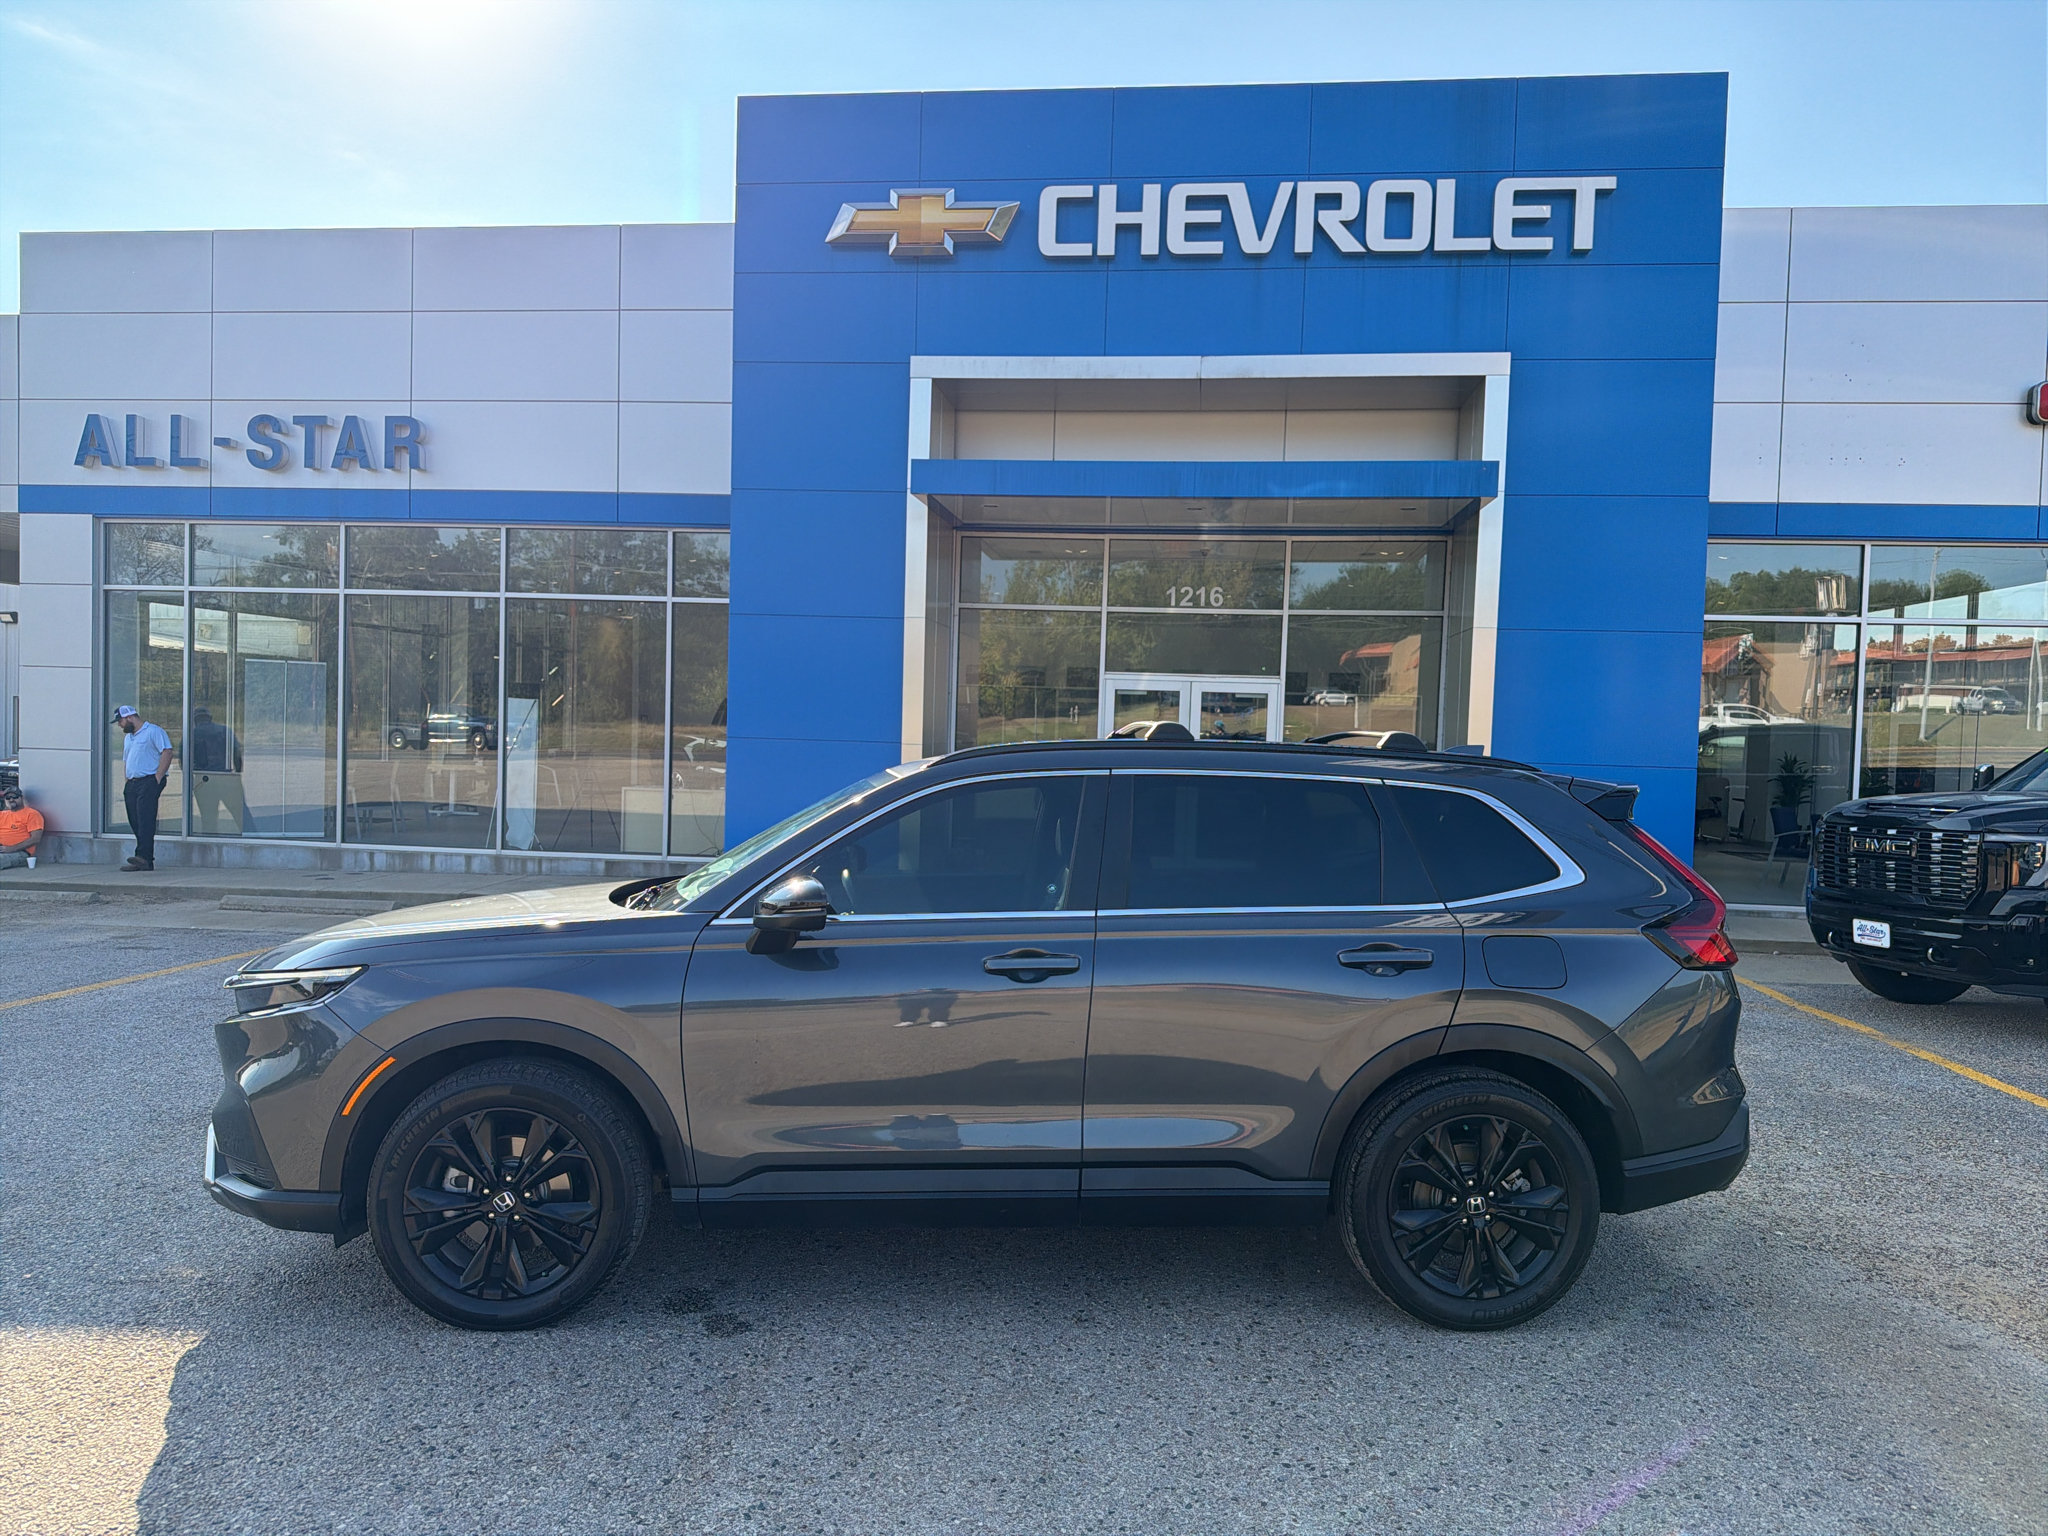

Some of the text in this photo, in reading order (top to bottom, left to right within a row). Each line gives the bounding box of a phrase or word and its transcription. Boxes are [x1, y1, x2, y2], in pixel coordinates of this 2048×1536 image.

[1038, 176, 1617, 257] CHEVROLET
[74, 413, 428, 472] ALL-STAR
[1166, 585, 1224, 608] 1216
[1853, 837, 1911, 855] GMC
[1421, 1095, 1488, 1118] MICHELIN
[391, 1106, 440, 1168] MICHELIN
